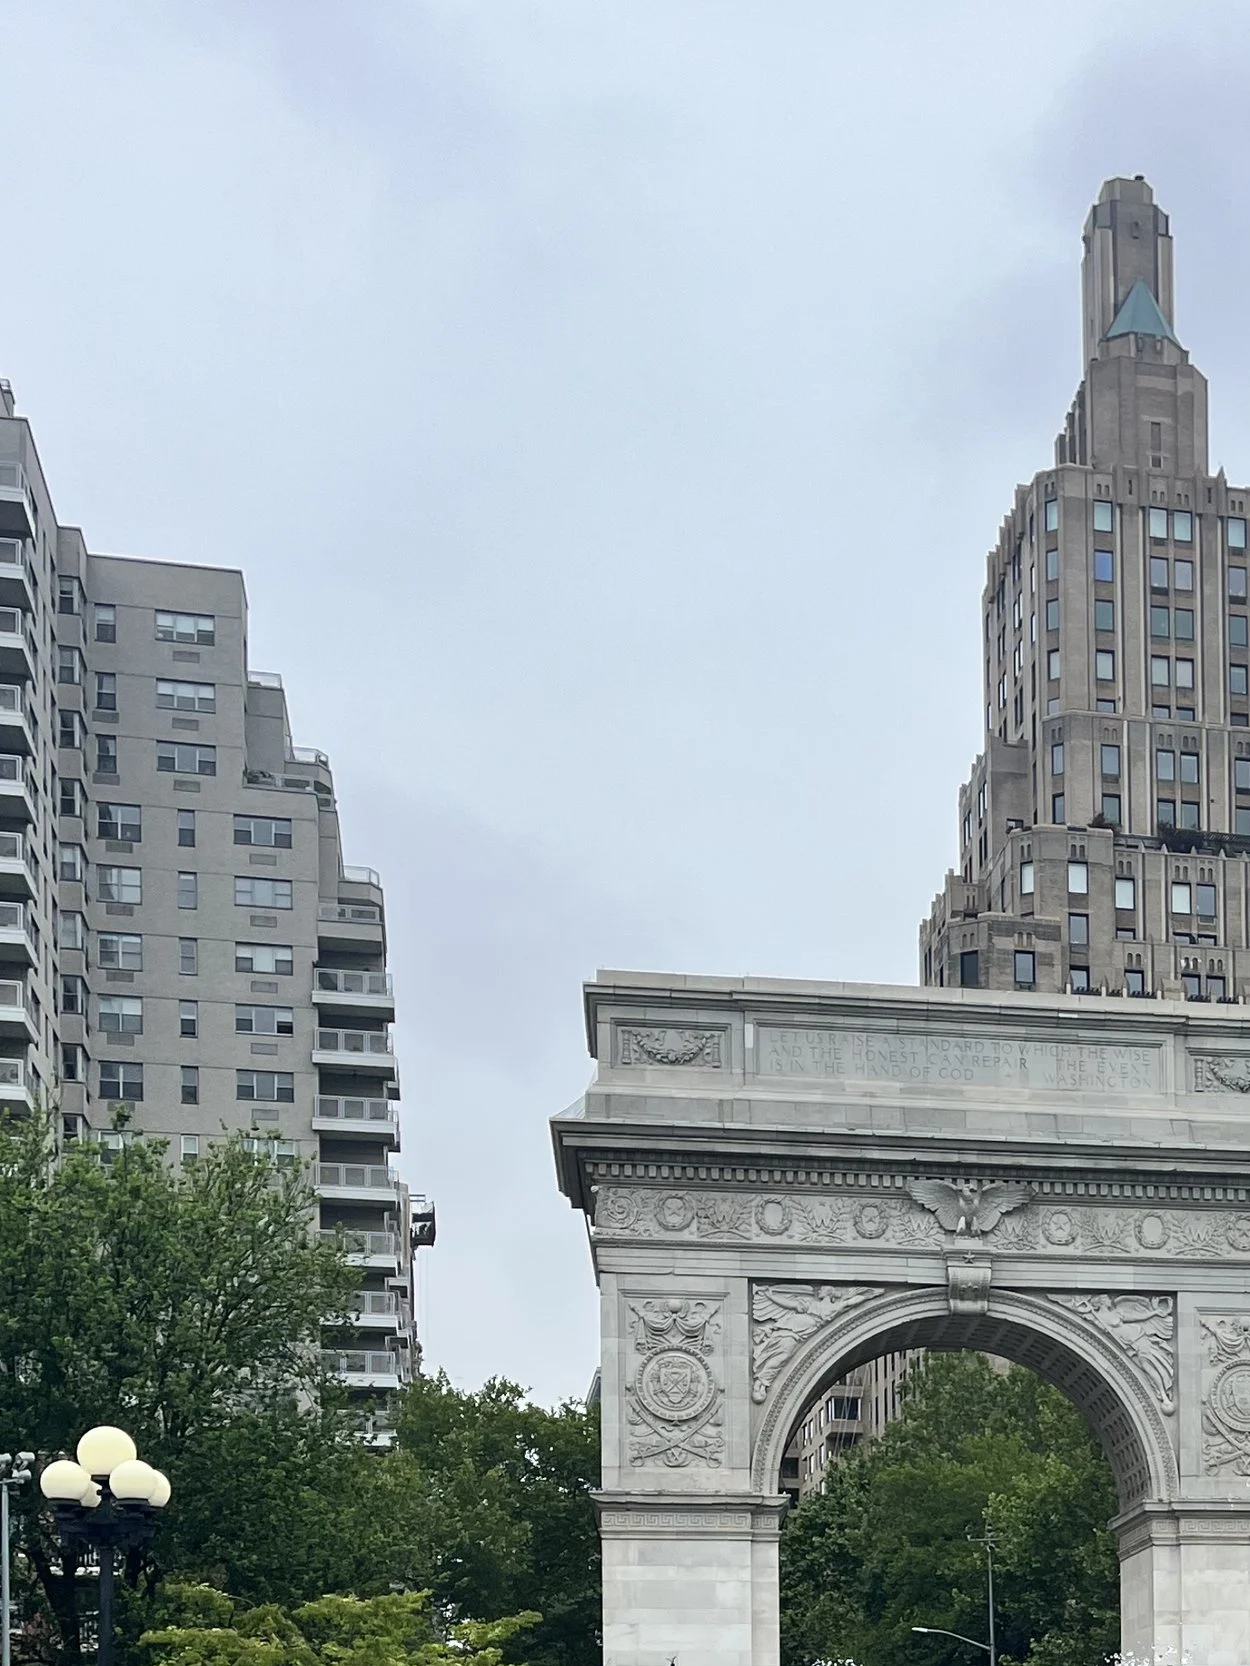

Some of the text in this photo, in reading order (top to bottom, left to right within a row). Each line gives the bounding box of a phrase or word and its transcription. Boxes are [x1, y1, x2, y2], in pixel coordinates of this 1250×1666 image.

[768, 1045, 1151, 1076] AND THE HONEST CAN REPAIR THE EVENT
[770, 1030, 1151, 1062] LET US RAISE A STANDARD TO WHICH THE WISE
[769, 1058, 783, 1072] IS
[790, 1059, 804, 1072] IN
[812, 1060, 845, 1074] THE
[855, 1063, 901, 1077] HAND
[909, 1066, 931, 1079] OF
[1043, 1072, 1152, 1089] WASHINGTON
